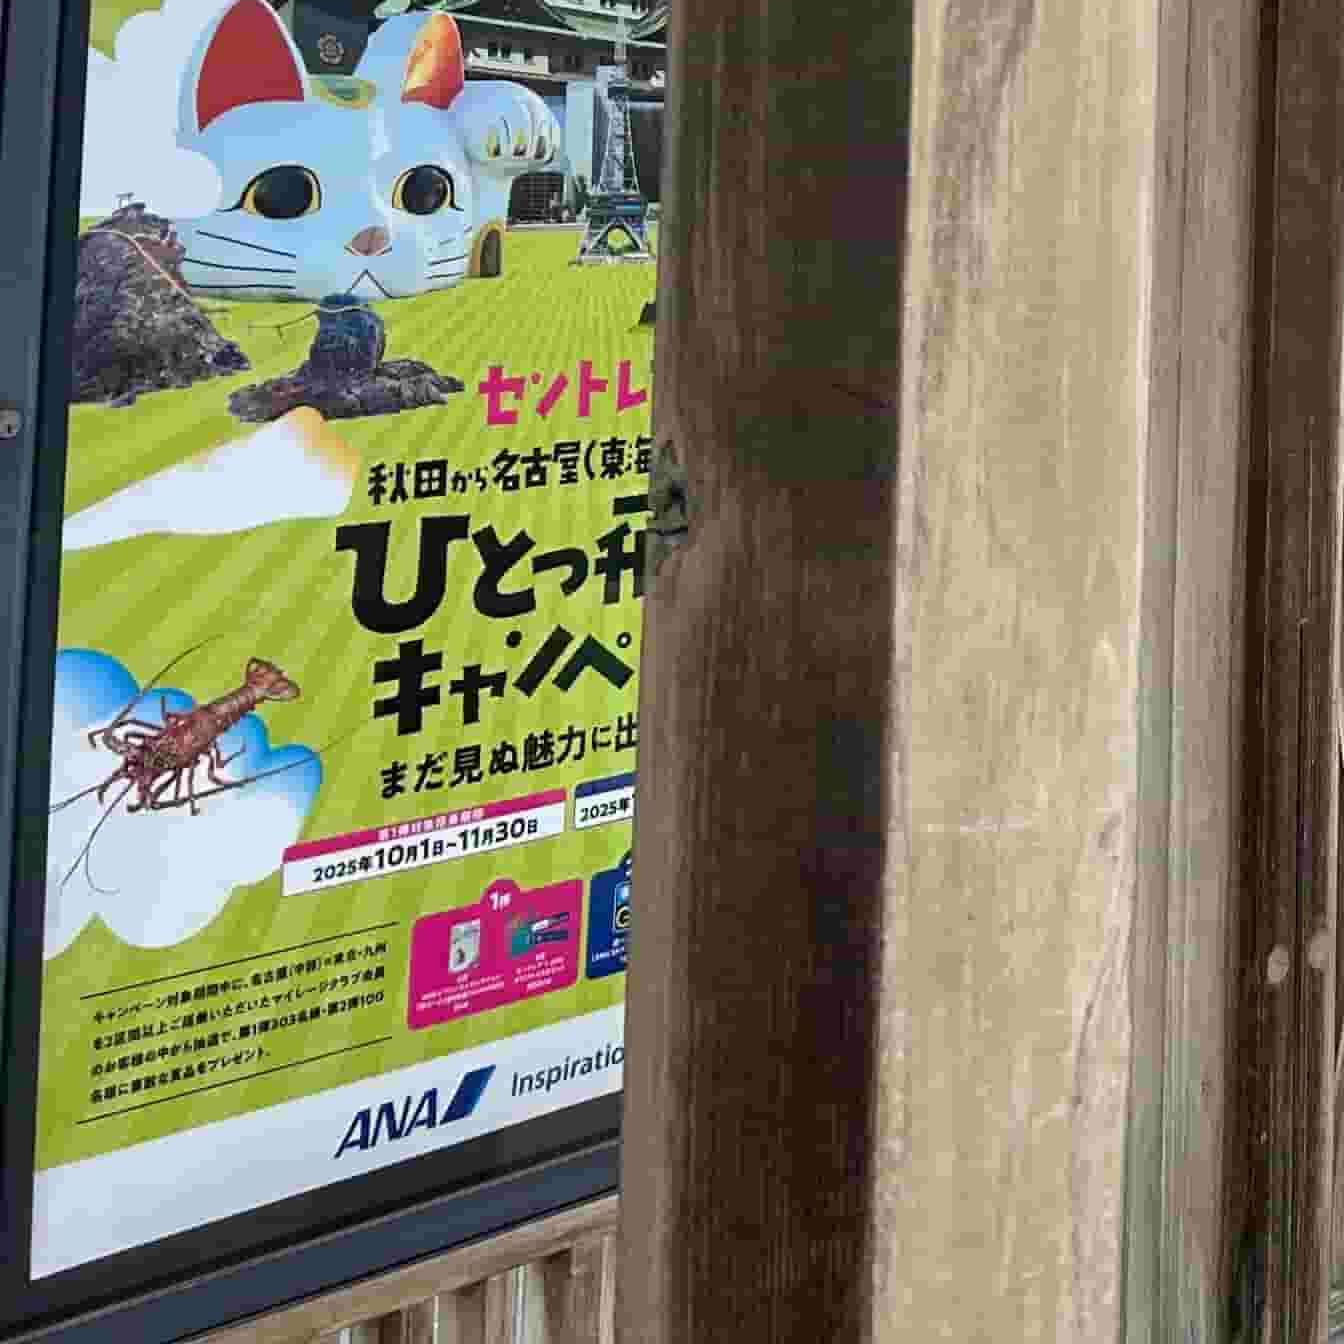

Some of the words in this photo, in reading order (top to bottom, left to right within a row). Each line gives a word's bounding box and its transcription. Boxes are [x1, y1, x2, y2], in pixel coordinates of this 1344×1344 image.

[373, 624, 635, 736] キャンペ
[579, 796, 635, 822] 2025年
[333, 1087, 438, 1159] ANA
